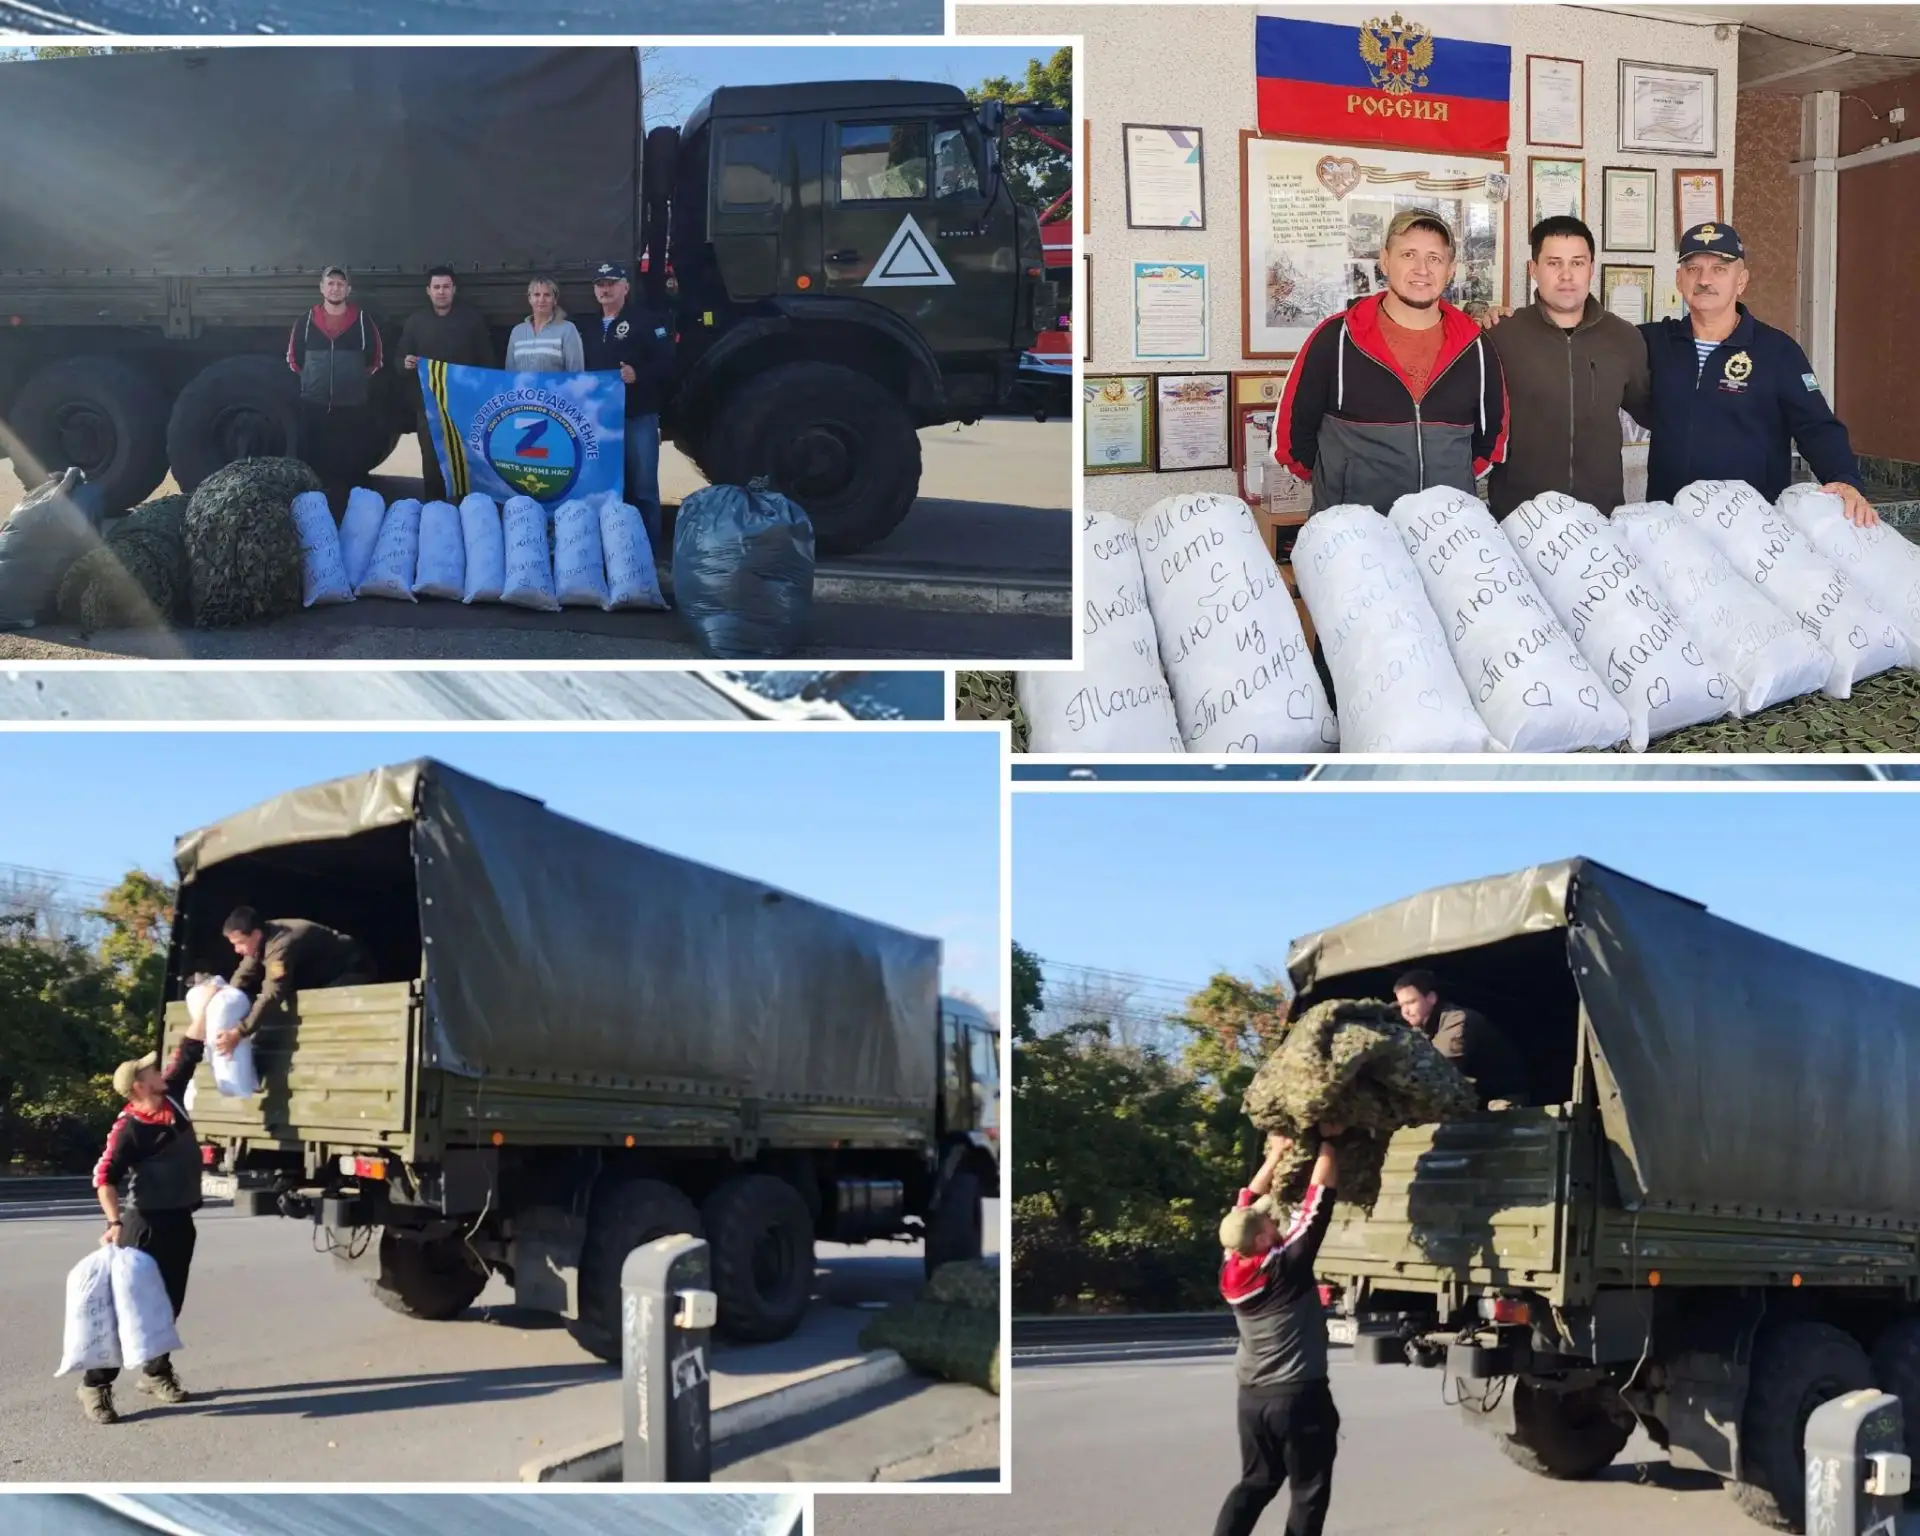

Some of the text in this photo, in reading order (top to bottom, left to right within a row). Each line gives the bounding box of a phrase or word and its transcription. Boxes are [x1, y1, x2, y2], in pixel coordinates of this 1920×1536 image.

[1346, 94, 1449, 122] РОССИЯ
[470, 388, 599, 460] ВОЛОНТЕРСКОЕ ДВИЖЕНИЕ
[523, 465, 549, 475] КРОМЕ
[1160, 528, 1225, 583] сеть
[1428, 525, 1481, 575] сеть
[1479, 547, 1502, 564] с
[1536, 520, 1598, 576] сеть
[1590, 547, 1609, 562] с
[1210, 561, 1231, 583] с
[1625, 584, 1660, 612] из
[1236, 619, 1266, 655] из
[1190, 632, 1305, 741] Таганро
